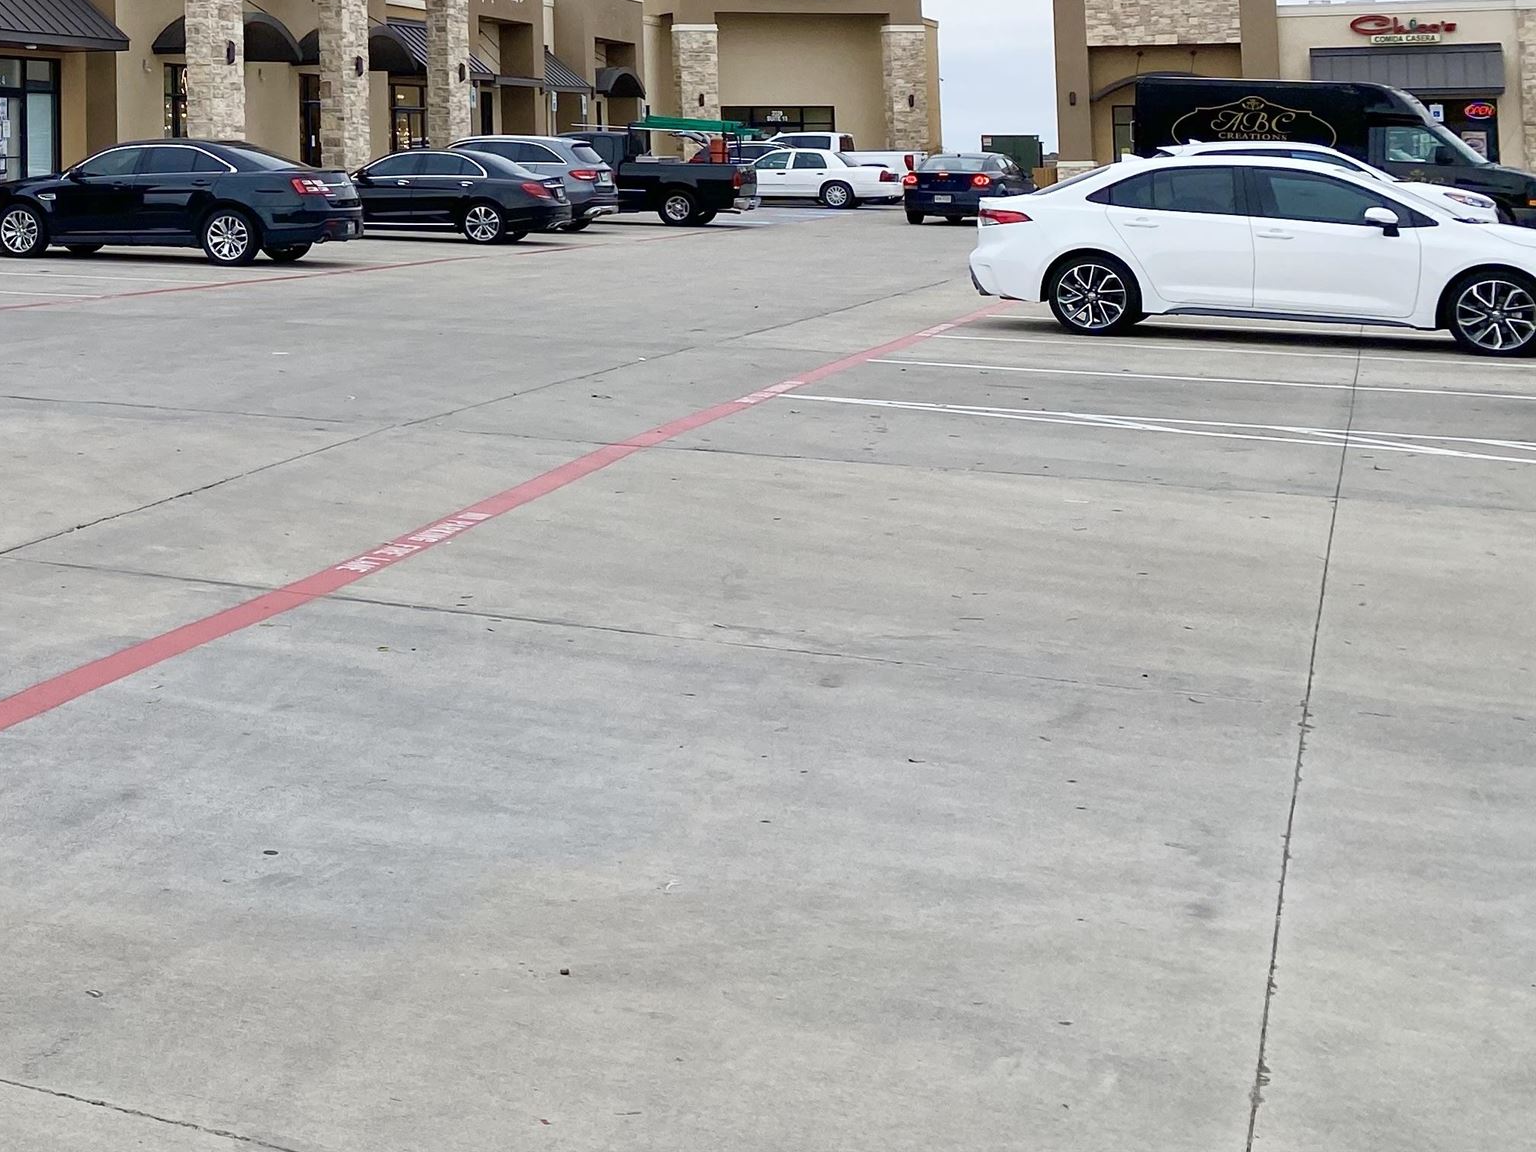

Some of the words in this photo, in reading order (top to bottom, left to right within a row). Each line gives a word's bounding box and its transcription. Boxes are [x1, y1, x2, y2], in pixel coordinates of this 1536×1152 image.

[1374, 35, 1404, 43] COMIDA
[1405, 34, 1436, 42] CASERA
[1210, 110, 1296, 134] ABC
[1218, 131, 1288, 141] CREATIONS
